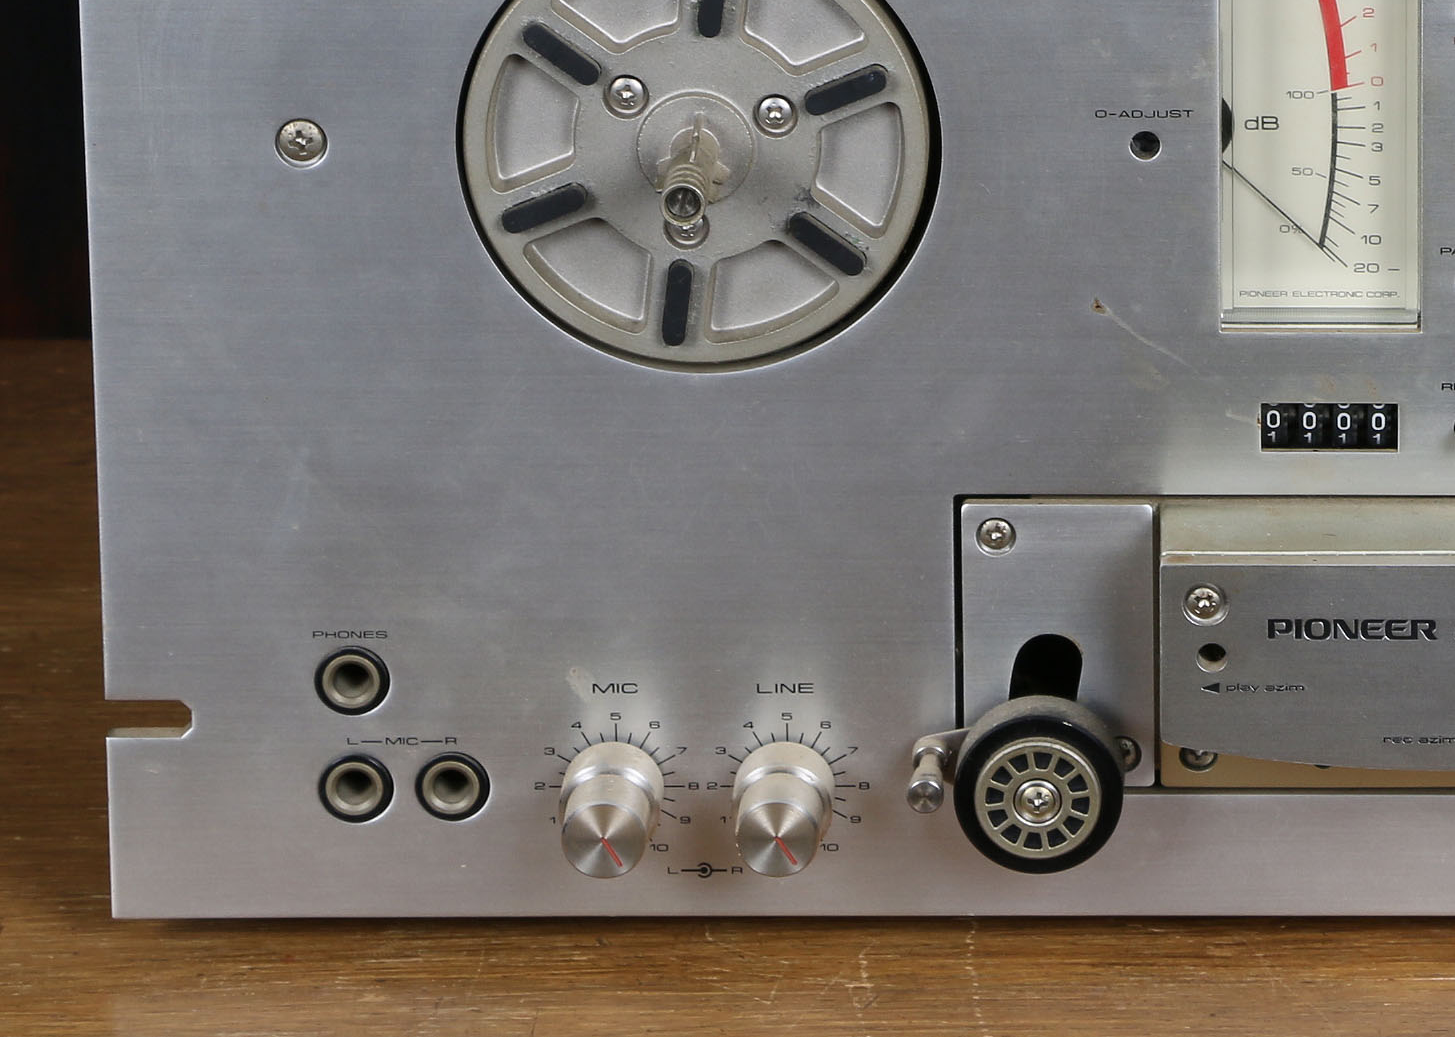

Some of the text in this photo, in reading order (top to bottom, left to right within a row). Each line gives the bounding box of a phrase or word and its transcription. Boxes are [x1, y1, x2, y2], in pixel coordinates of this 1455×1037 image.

[1285, 90, 1315, 100] 100
[1244, 115, 1280, 131] dB
[1291, 165, 1314, 177] 50
[1360, 234, 1382, 246] 10
[1353, 262, 1380, 274] 20
[1238, 290, 1288, 298] PIONEER
[1291, 290, 1364, 300] ELECTRONIC
[312, 630, 389, 640] PHONES
[1267, 617, 1438, 642] PIONEER
[592, 682, 639, 694] MIC
[756, 682, 814, 694] LINE
[346, 736, 457, 746] L MIC R
[666, 865, 744, 875] L R
